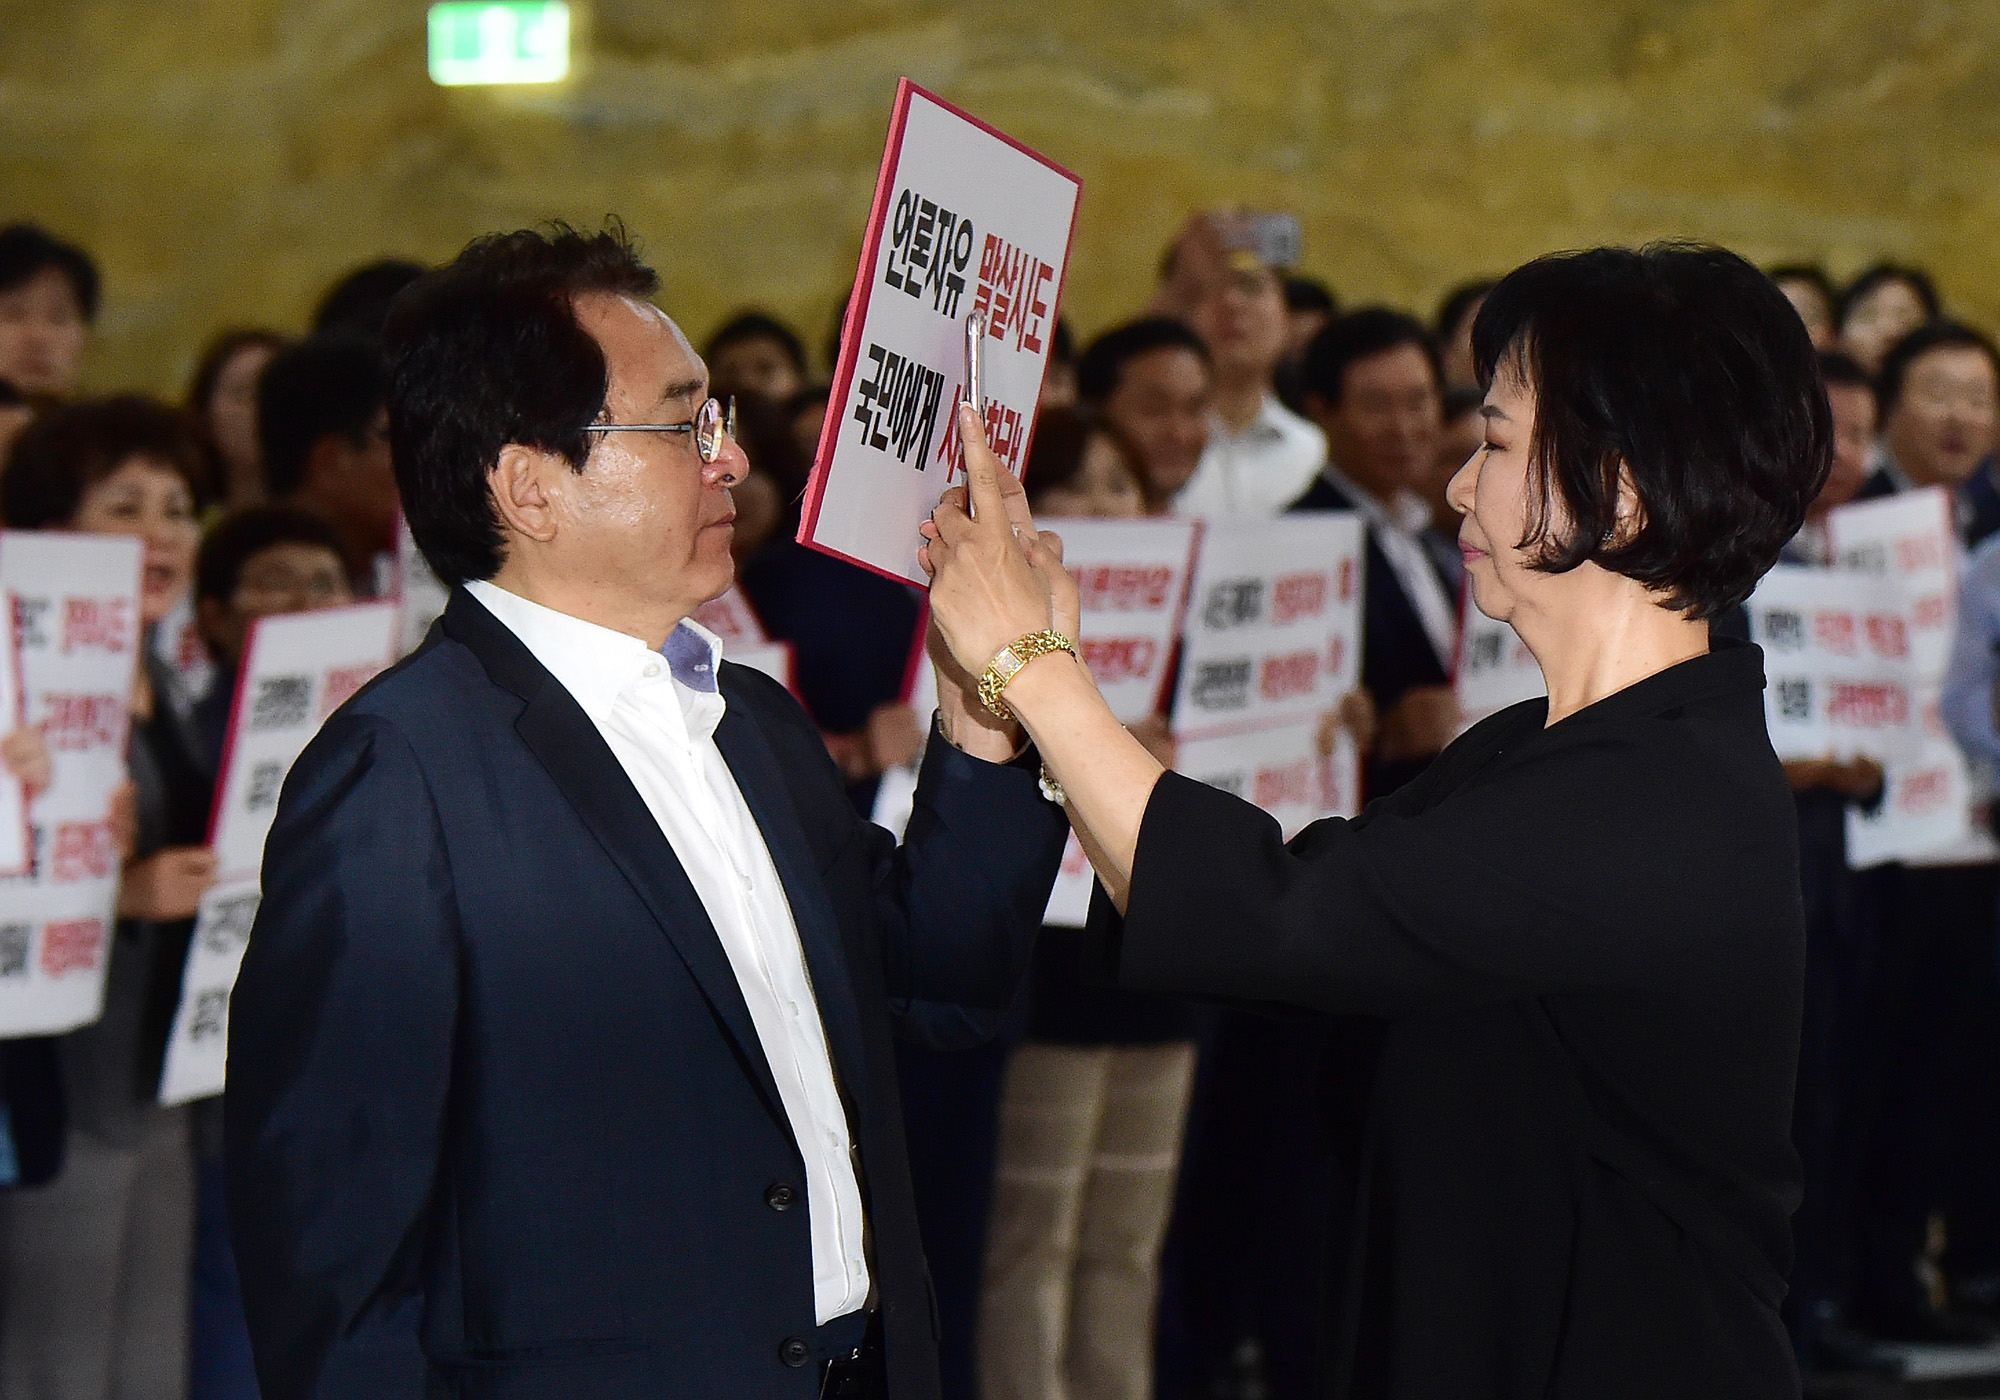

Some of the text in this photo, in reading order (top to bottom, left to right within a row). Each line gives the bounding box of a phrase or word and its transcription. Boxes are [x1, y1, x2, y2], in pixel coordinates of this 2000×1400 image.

[885, 188, 1054, 354] 언론자유 말살시도
[854, 343, 945, 472] 국민에게
